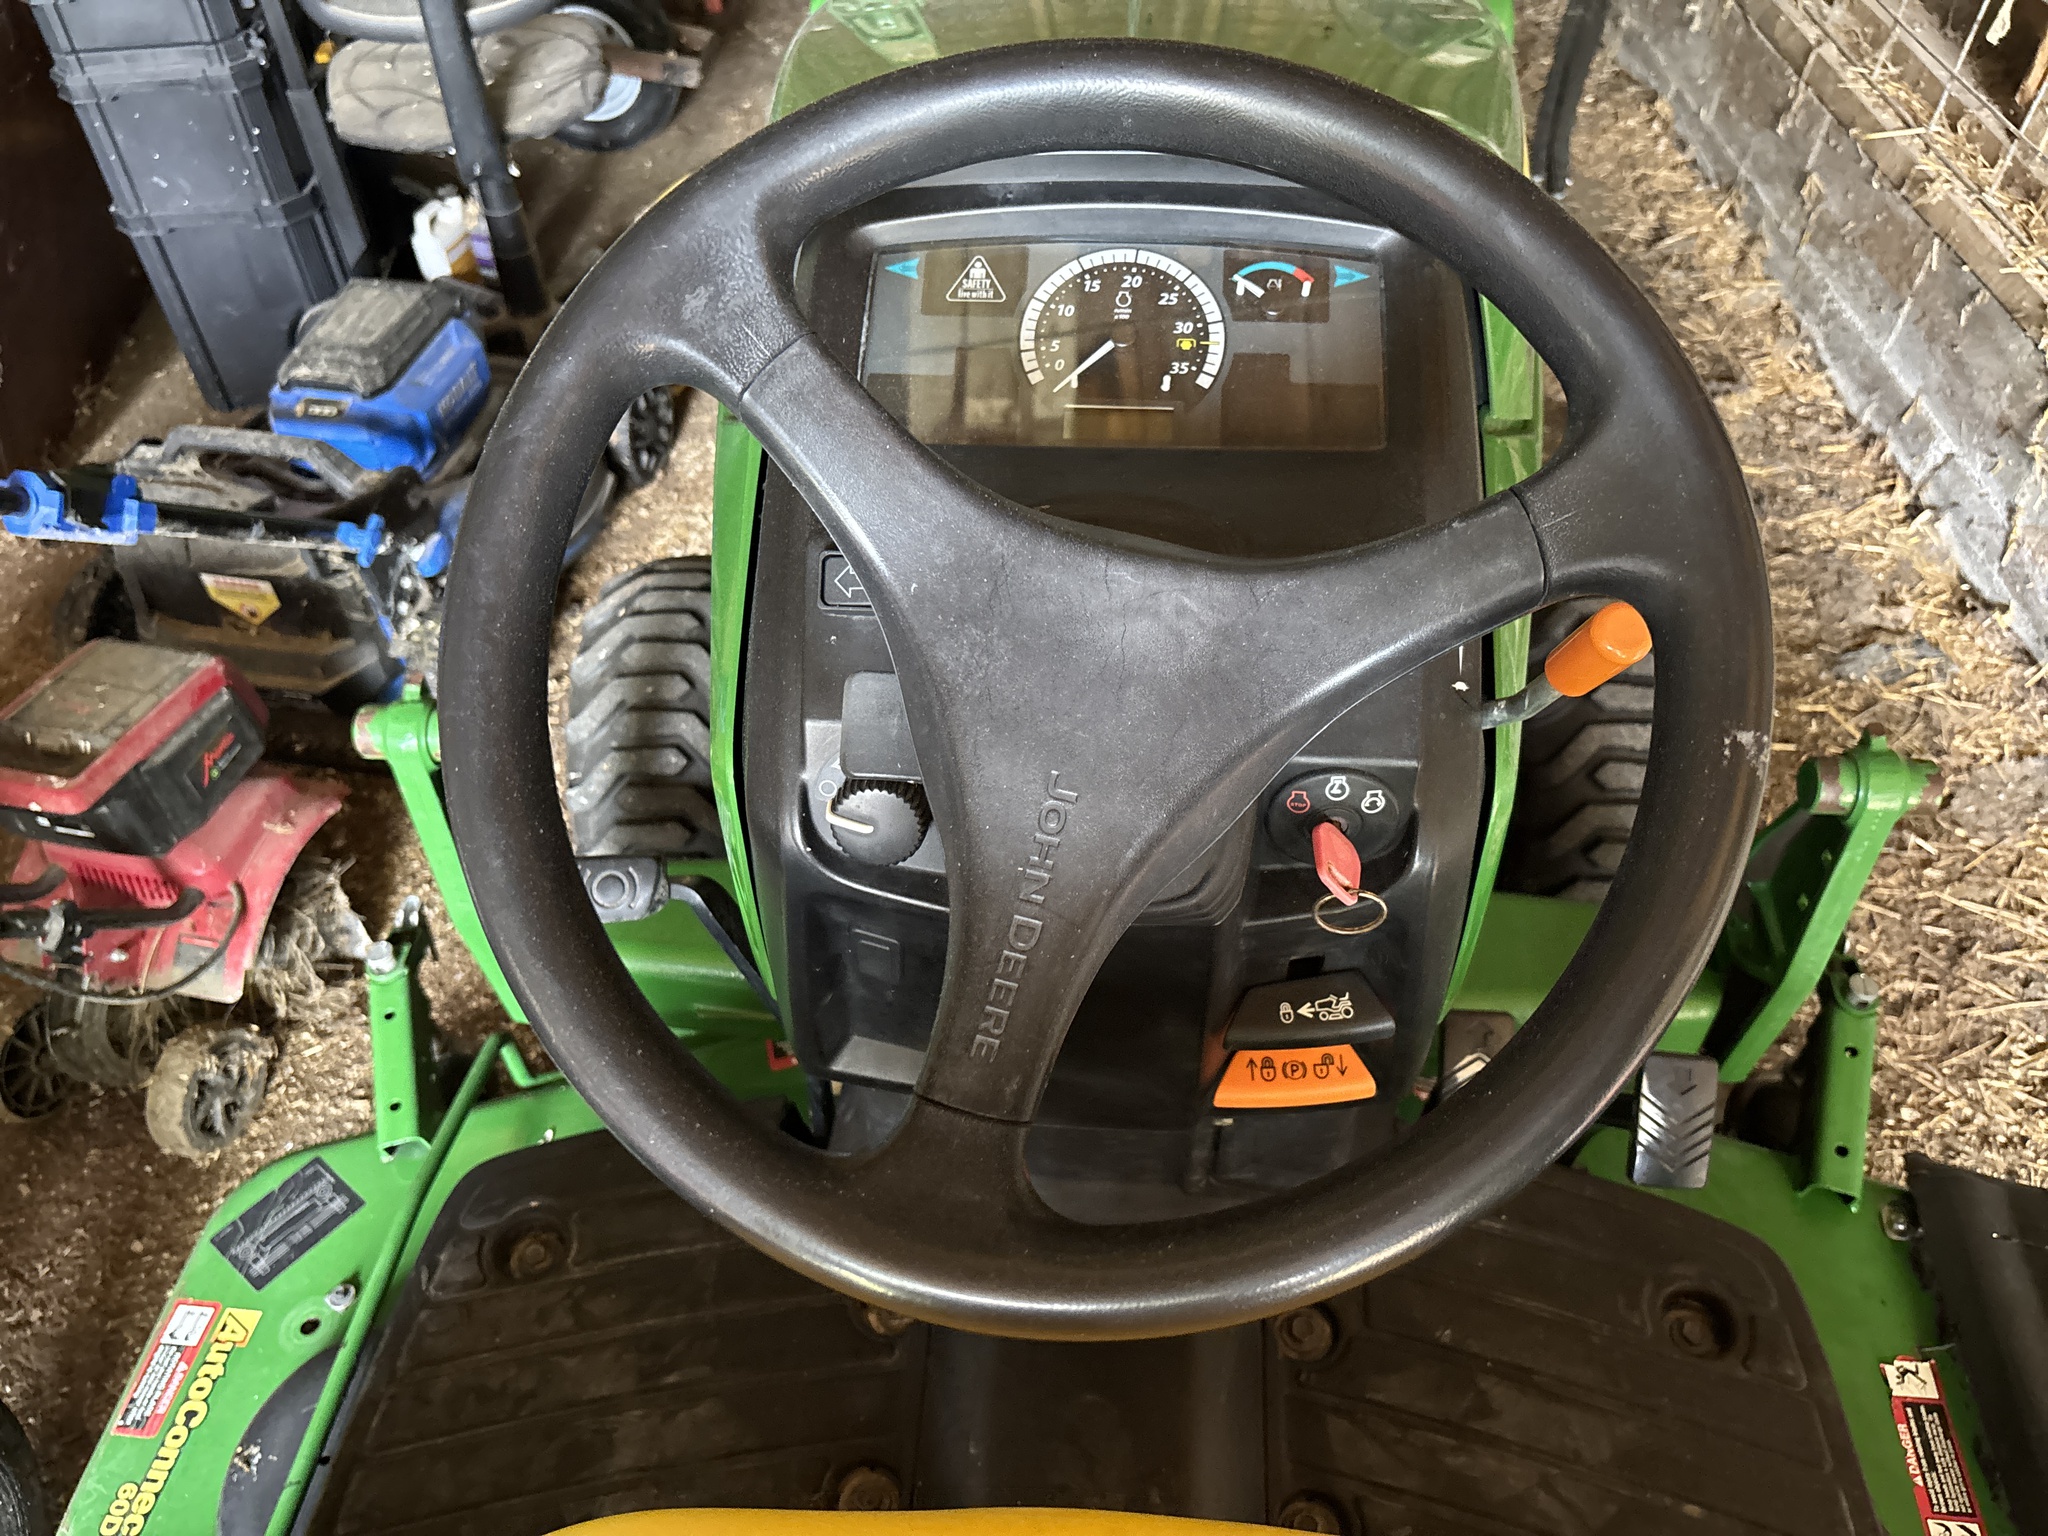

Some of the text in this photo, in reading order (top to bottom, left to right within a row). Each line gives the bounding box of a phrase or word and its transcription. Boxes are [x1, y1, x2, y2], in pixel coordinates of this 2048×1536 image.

[962, 279, 991, 288] SAFETY
[1084, 280, 1101, 292] 15
[1121, 275, 1142, 288] 20
[957, 288, 994, 298] live with it
[1158, 293, 1179, 305] 25
[1058, 304, 1075, 317] 10
[1173, 322, 1194, 334] 30
[1050, 340, 1061, 352] 5
[1054, 359, 1065, 371] 0
[1169, 362, 1190, 374] 35
[969, 770, 1078, 1063] JOHN DEERE
[1897, 1423, 1920, 1475] DANGER
[99, 1482, 139, 1536] 60D
